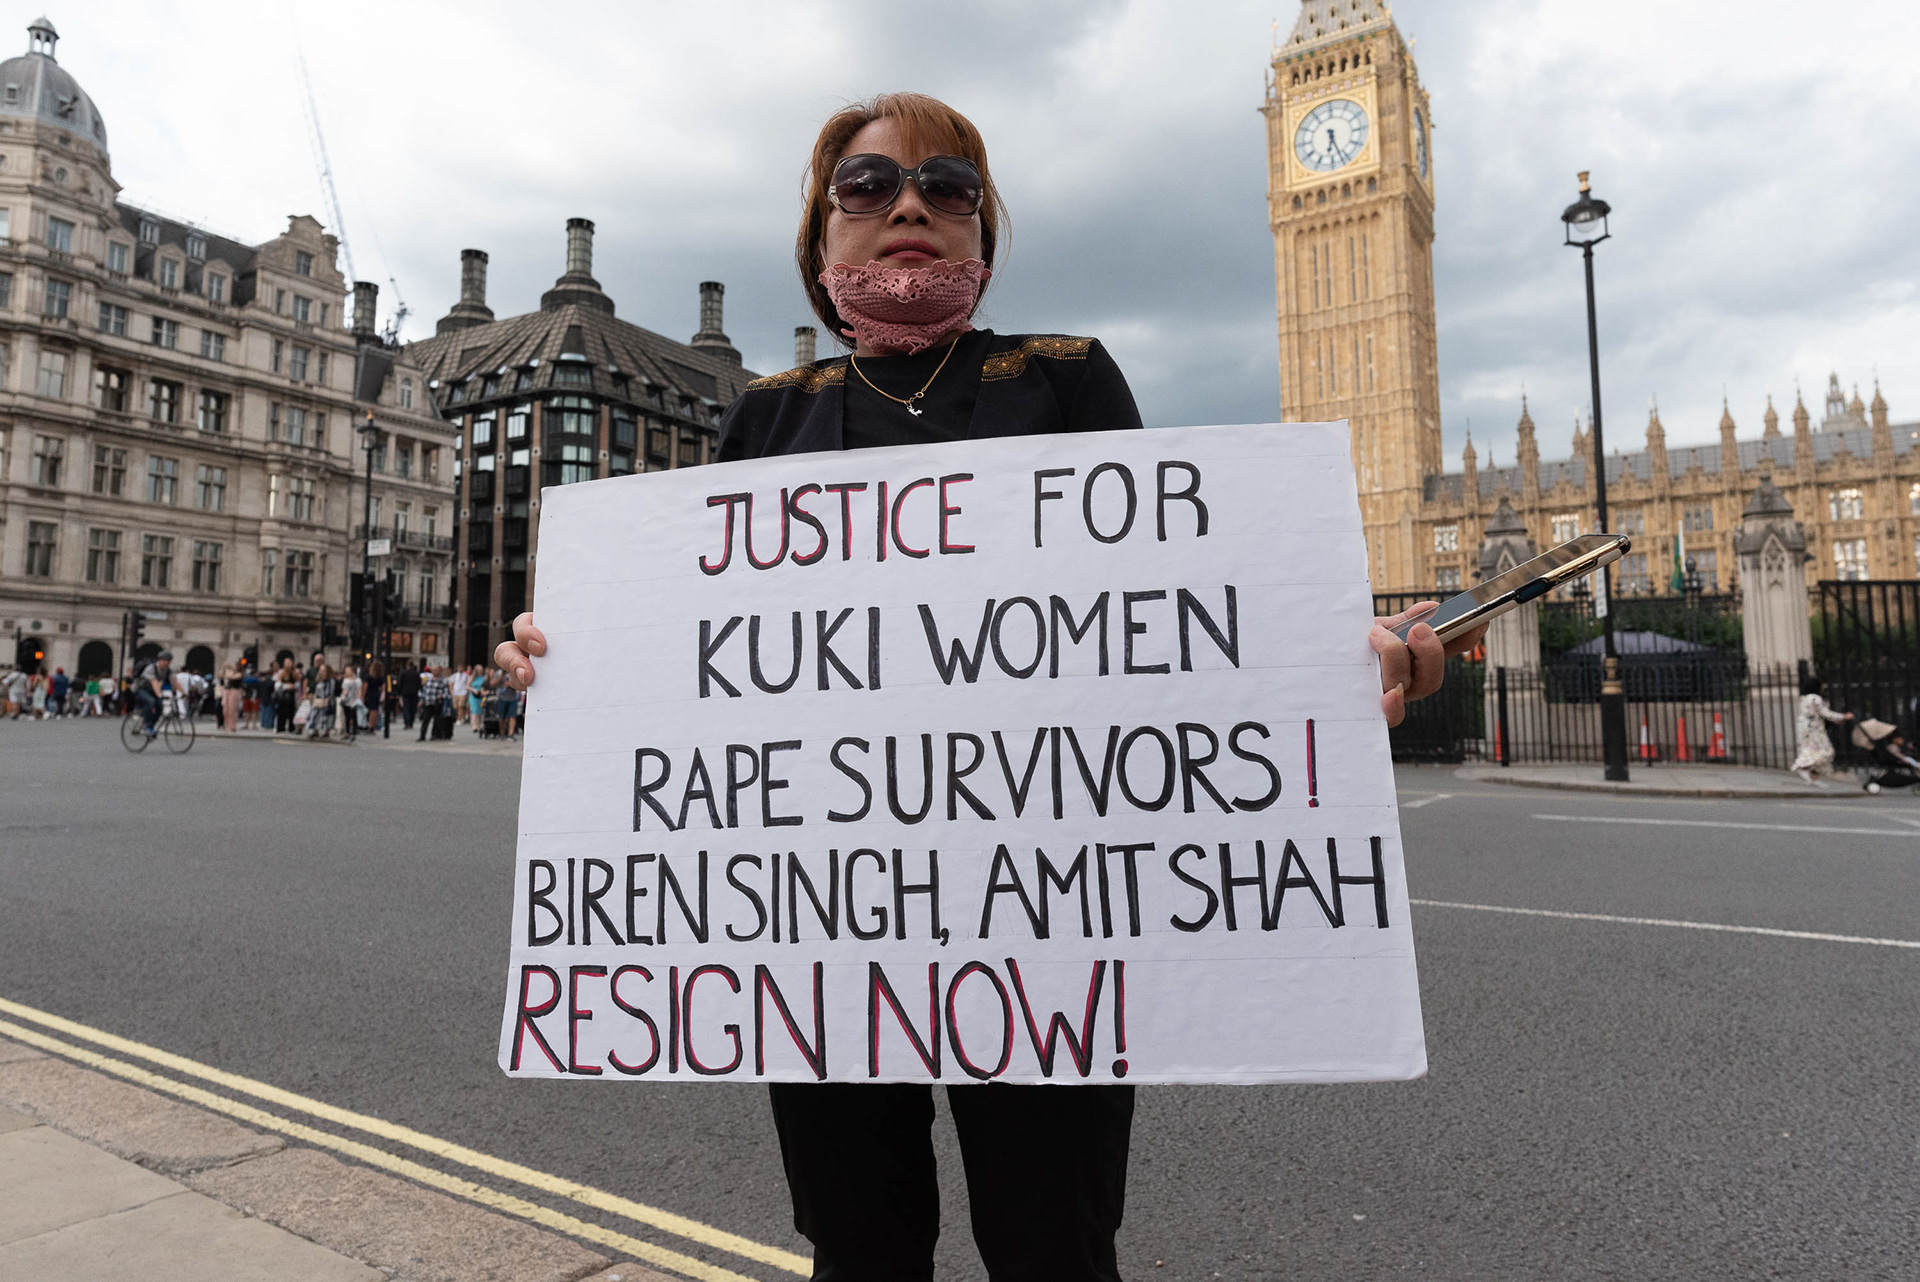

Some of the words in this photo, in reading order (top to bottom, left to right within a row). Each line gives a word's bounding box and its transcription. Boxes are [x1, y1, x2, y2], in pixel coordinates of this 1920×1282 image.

[699, 473, 976, 576] JUSTICE
[1034, 461, 1209, 549] FOR
[699, 606, 882, 699] KUKI
[917, 585, 1240, 686] WOMEN
[633, 740, 804, 833] RAPE
[527, 851, 709, 947] BIREN
[978, 842, 1156, 940] AMIT
[1169, 836, 1390, 932] SHAH
[510, 961, 827, 1080] RESIGN
[868, 956, 1129, 1080] NOW!
